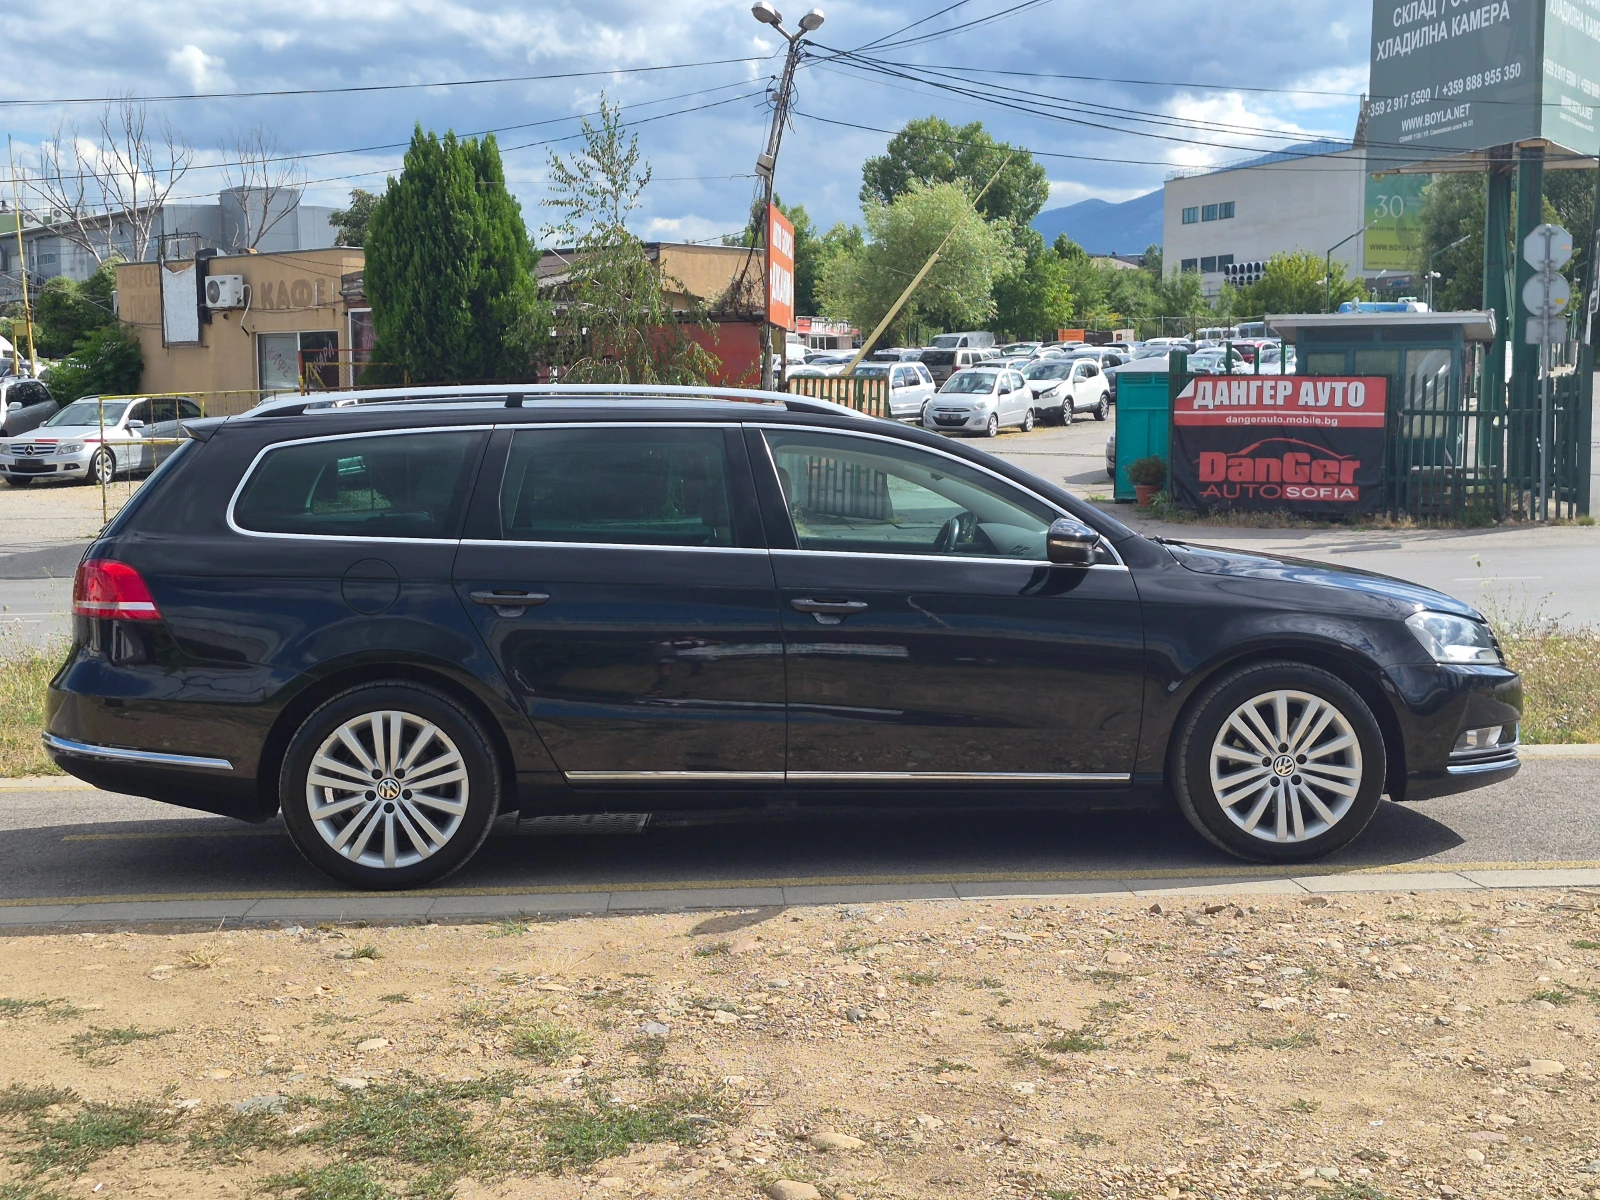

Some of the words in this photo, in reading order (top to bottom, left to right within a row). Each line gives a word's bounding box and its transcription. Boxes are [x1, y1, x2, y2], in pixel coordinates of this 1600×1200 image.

[1393, 0, 1437, 27] СКЛАД
[1376, 22, 1448, 61] ХЛАДИЛНА
[1451, 2, 1510, 38] КАМЕРА
[1386, 98, 1392, 113] 2
[1393, 93, 1409, 111] 917
[1410, 87, 1431, 106] 5500
[1442, 78, 1464, 97] +359
[1465, 73, 1483, 92] 888
[1484, 68, 1502, 86] 955
[1503, 62, 1521, 82] 350
[1401, 103, 1471, 132] WWW.BOYLA.NET
[1374, 194, 1404, 218] 30
[260, 278, 326, 310] КАФЕ
[1193, 380, 1293, 410] ДАНГЕР
[1298, 381, 1365, 407] АУТО
[1226, 415, 1338, 427] dangerauto.mobile.bg
[1199, 451, 1361, 484] DanGer
[1199, 484, 1282, 499] AUTO
[1286, 486, 1355, 499] SOFIA
